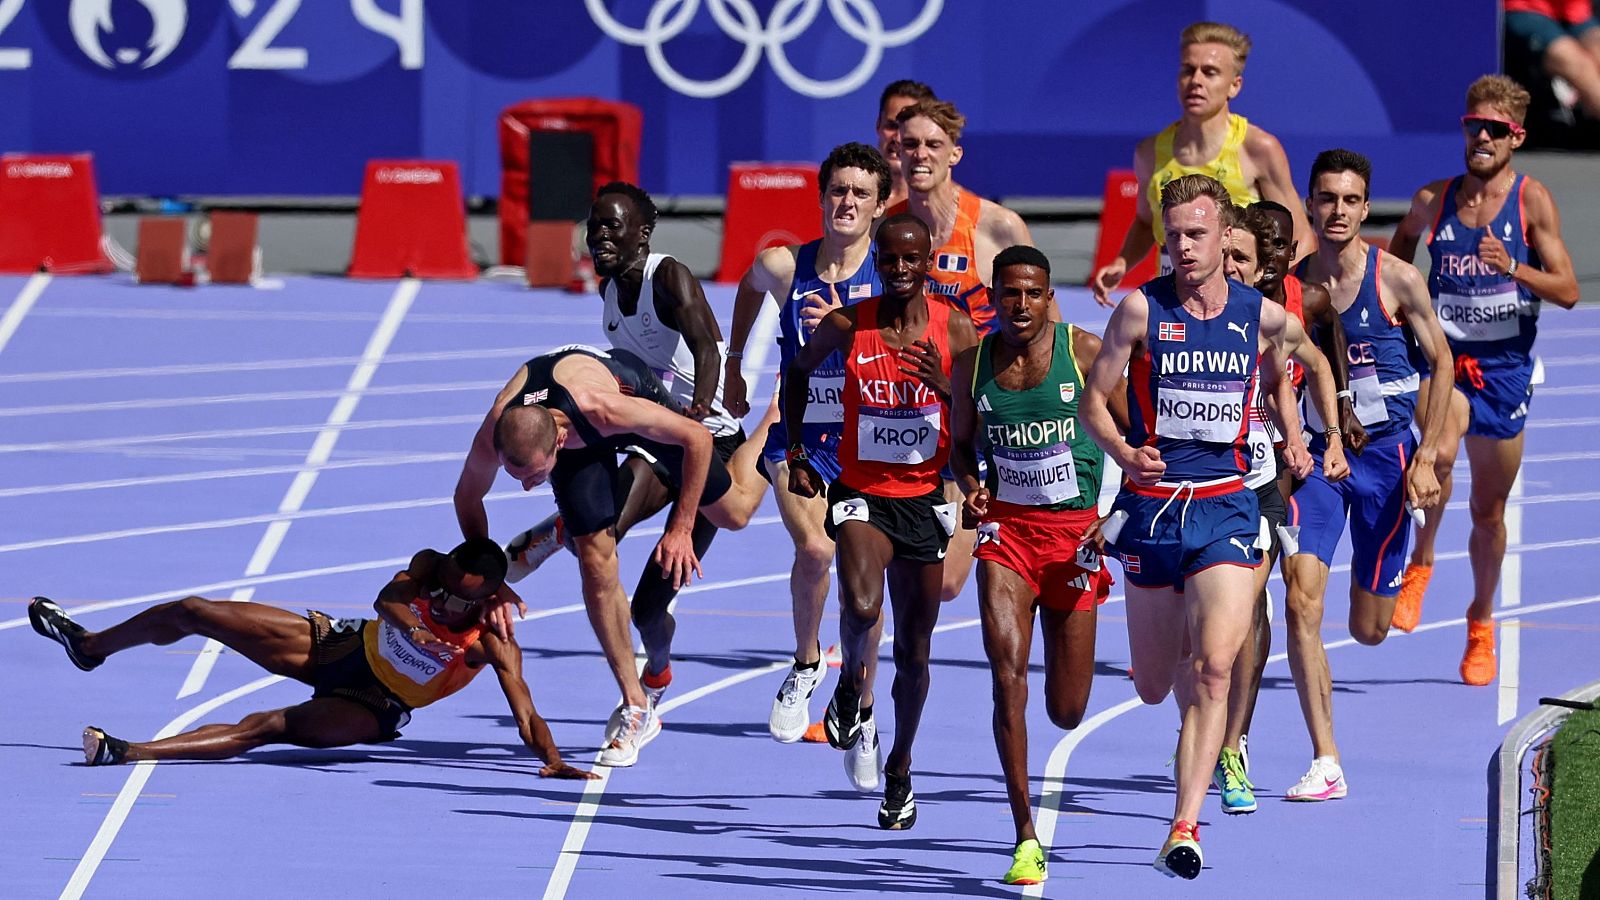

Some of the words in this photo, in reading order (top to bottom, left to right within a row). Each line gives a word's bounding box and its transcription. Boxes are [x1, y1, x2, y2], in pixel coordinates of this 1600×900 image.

[924, 281, 961, 297] land
[1440, 303, 1517, 323] GRESSIER
[1161, 350, 1250, 375] NORWAY
[859, 379, 937, 405] KENYA
[1160, 398, 1241, 422] NORDAS
[874, 426, 929, 447] KROP
[988, 417, 1076, 446] ETHIOPIA
[1007, 451, 1028, 459] PARIS
[1030, 450, 1049, 459] 2024
[999, 462, 1071, 488] GEBRHIWET
[843, 504, 858, 517] 2
